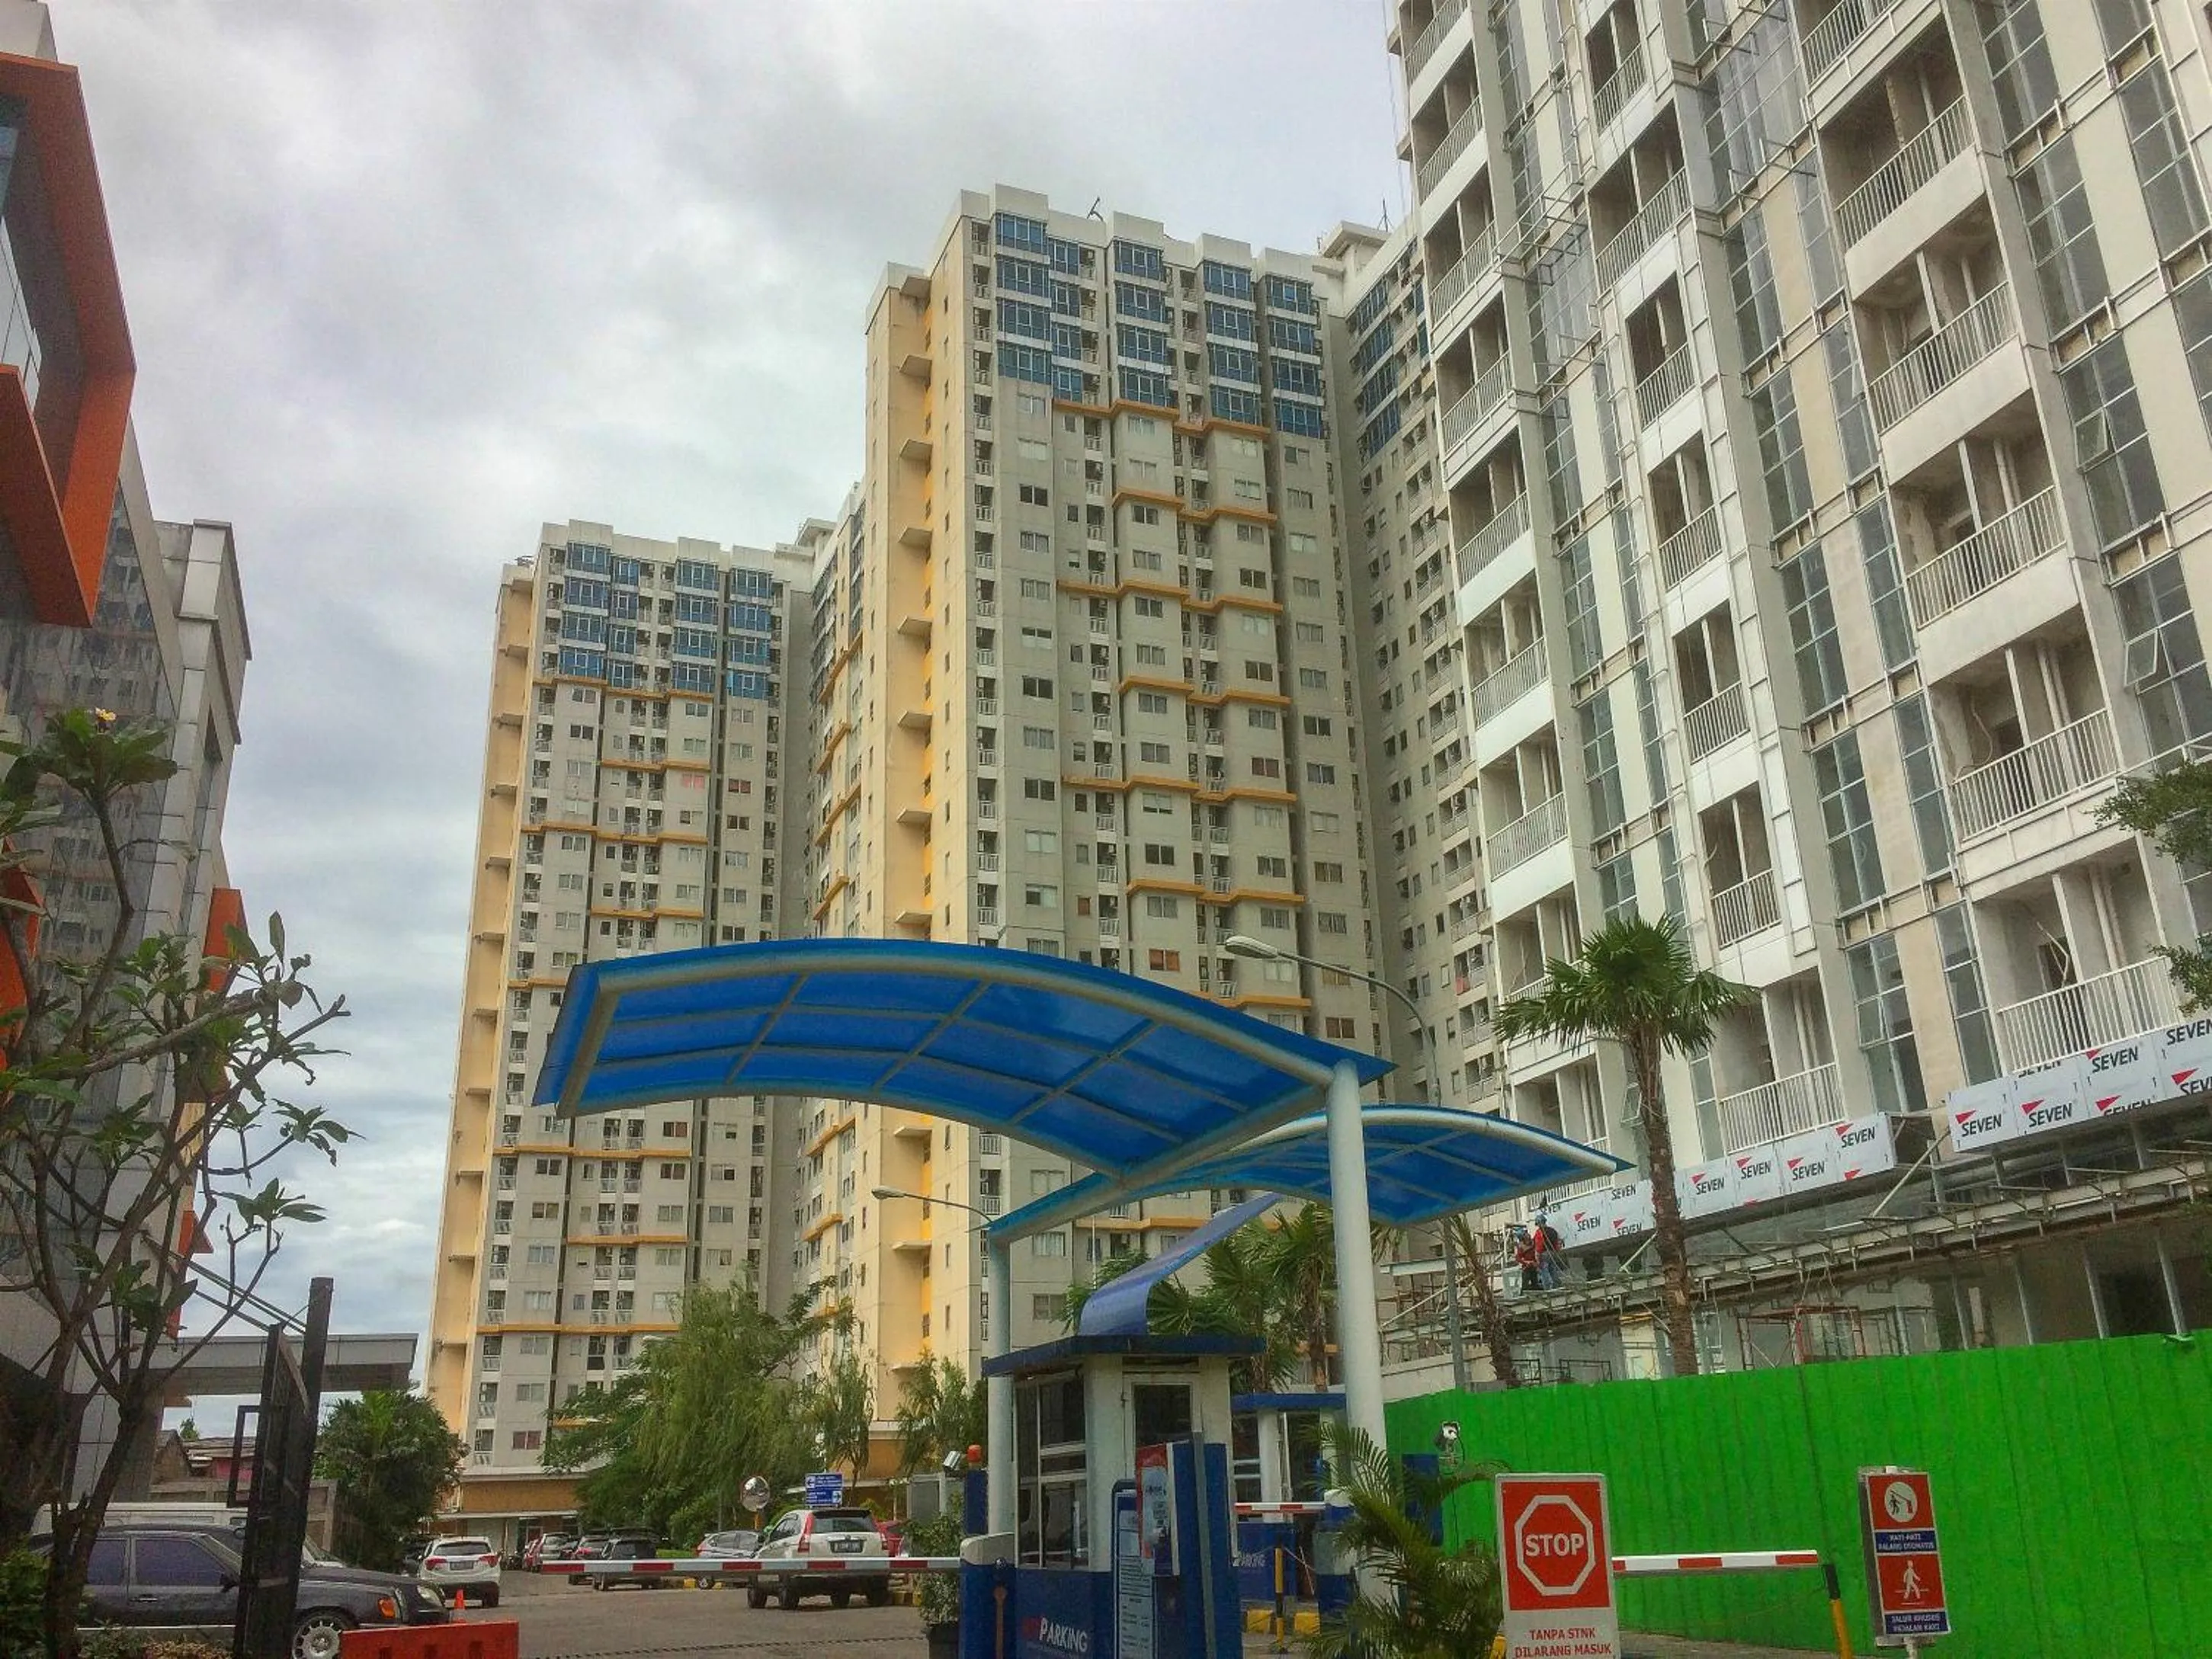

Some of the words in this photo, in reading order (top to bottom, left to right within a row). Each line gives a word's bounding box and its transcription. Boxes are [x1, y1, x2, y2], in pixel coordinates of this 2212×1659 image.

[2166, 1018, 2212, 1046] SEVEN
[2092, 1046, 2139, 1073] SEVEN
[2180, 1076, 2212, 1096] SEV
[1961, 1113, 2002, 1137] SEVEN
[2028, 1103, 2073, 1127] SEVEN
[1841, 1126, 1876, 1148] SEVEN
[1741, 1161, 1771, 1180] SEVEN
[1792, 1161, 1825, 1180] SEVEN
[1611, 1183, 1637, 1200] SEVEN
[1695, 1177, 1725, 1195] SEVEN
[1577, 1215, 1601, 1231] SEVEN
[1525, 1533, 1585, 1557] STOP
[1039, 1617, 1088, 1653] PARKING
[1530, 1629, 1566, 1640] TANPA
[1569, 1627, 1596, 1638] STNK
[1515, 1645, 1571, 1657] DILARANG
[1575, 1643, 1612, 1654] MASUK
